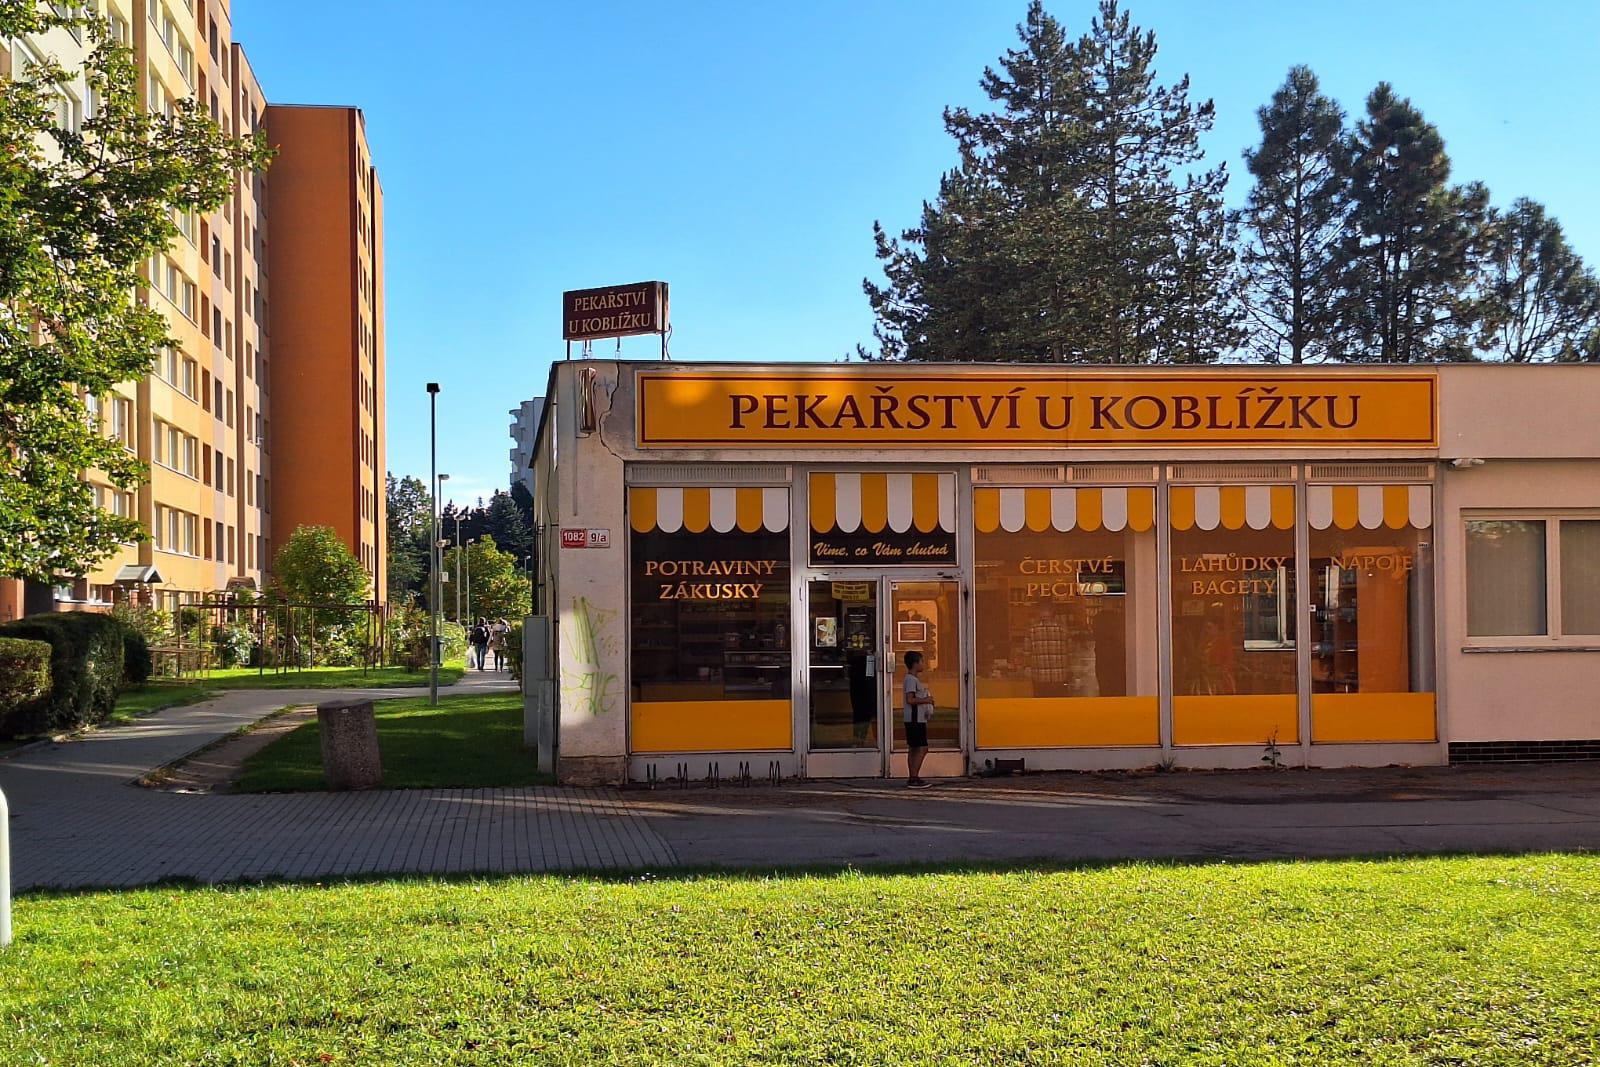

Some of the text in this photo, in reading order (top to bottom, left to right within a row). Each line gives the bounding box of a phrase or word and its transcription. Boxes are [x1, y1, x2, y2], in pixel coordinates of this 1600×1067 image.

[574, 287, 648, 312] PEKAŘSTVÍ
[569, 311, 651, 333] U KOBLÍŽKU
[728, 385, 1361, 430] PEKAŘSTVÍ U KOBLÍŽKU
[563, 532, 585, 541] 1082
[855, 547, 869, 556] co
[872, 542, 902, 556] Vám
[906, 542, 948, 556] chutná
[644, 560, 777, 576] POTRAVINY
[1019, 556, 1114, 575] ČERSTVÉ
[1180, 553, 1287, 572] LAHŮDKY
[1330, 552, 1414, 571] NÁPOJE
[659, 581, 763, 599] ZÁKUSKY
[1027, 579, 1107, 597] PEČIVO
[1191, 579, 1277, 595] BAGETY
